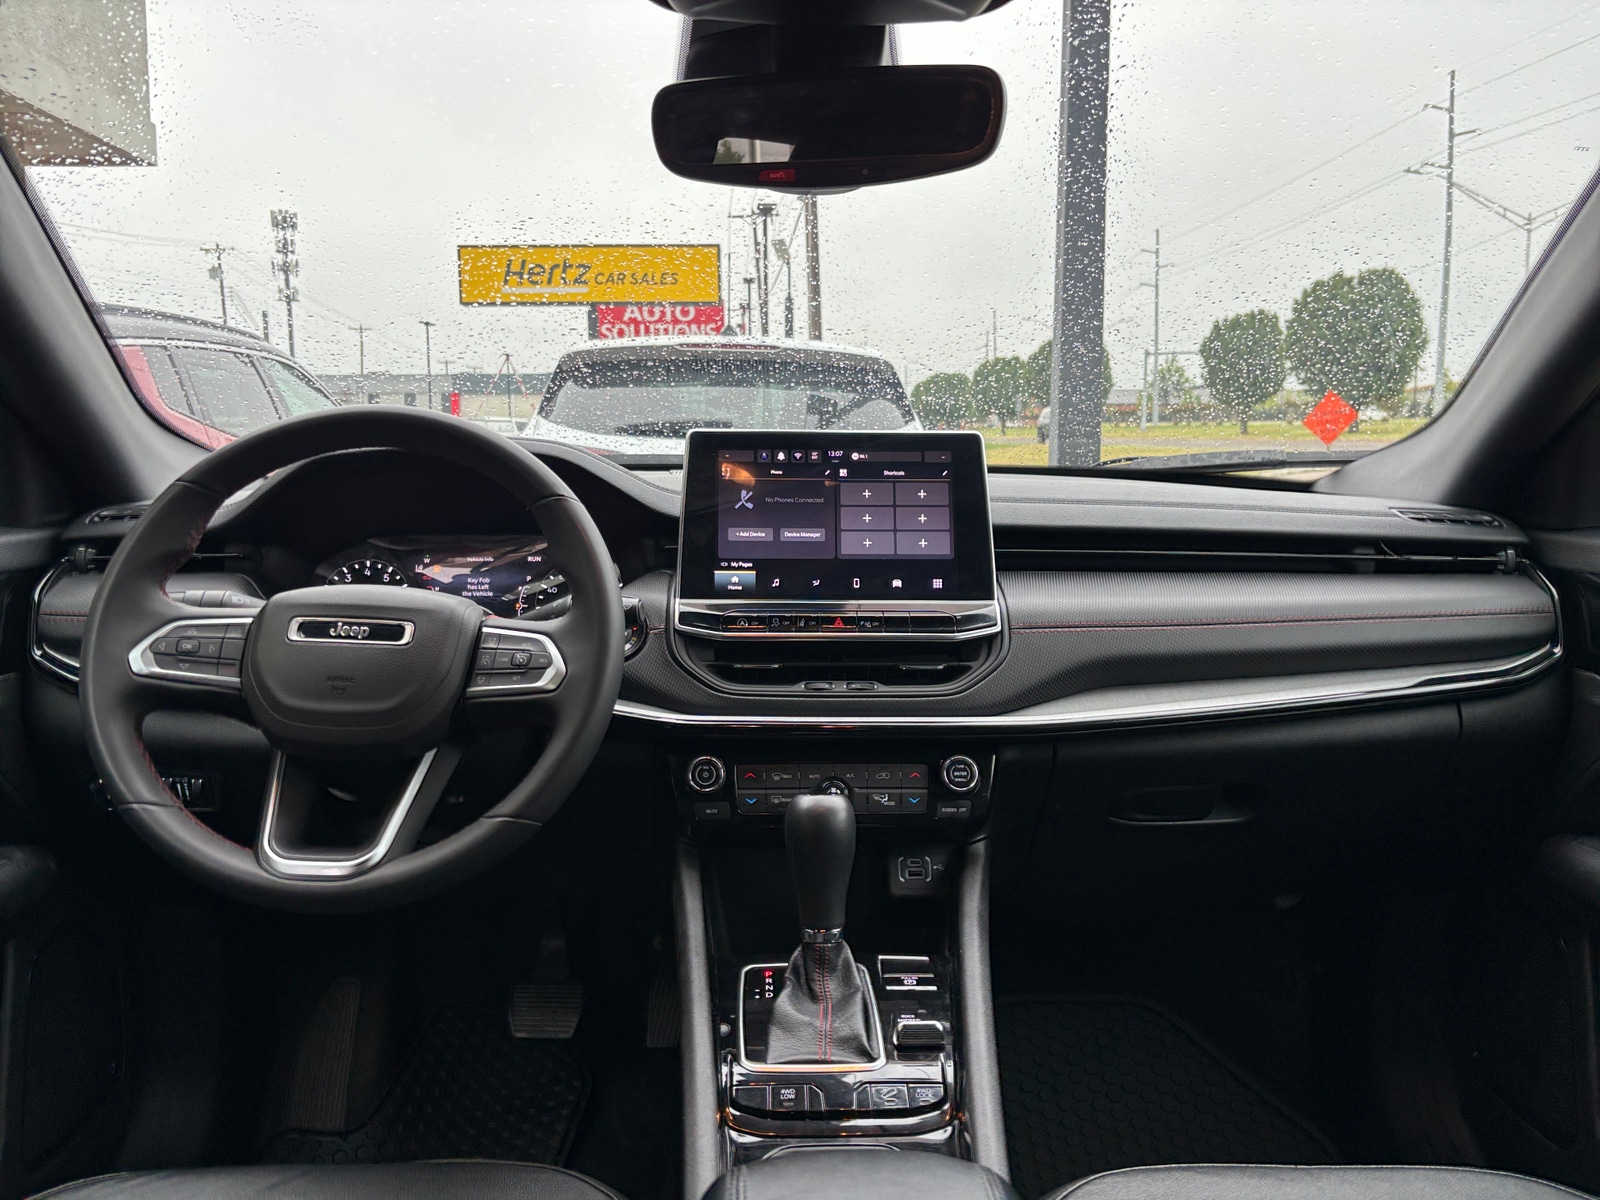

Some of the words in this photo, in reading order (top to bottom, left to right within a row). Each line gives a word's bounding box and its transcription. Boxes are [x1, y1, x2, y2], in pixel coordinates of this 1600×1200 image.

[502, 259, 593, 286] Hertz
[594, 272, 625, 285] CAR
[629, 272, 679, 285] SALES
[623, 305, 696, 322] AUTO
[600, 322, 718, 339] SOLUTIONS
[345, 574, 352, 582] 3
[364, 568, 371, 577] 4
[383, 573, 390, 582] 5
[329, 622, 370, 639] Jeep
